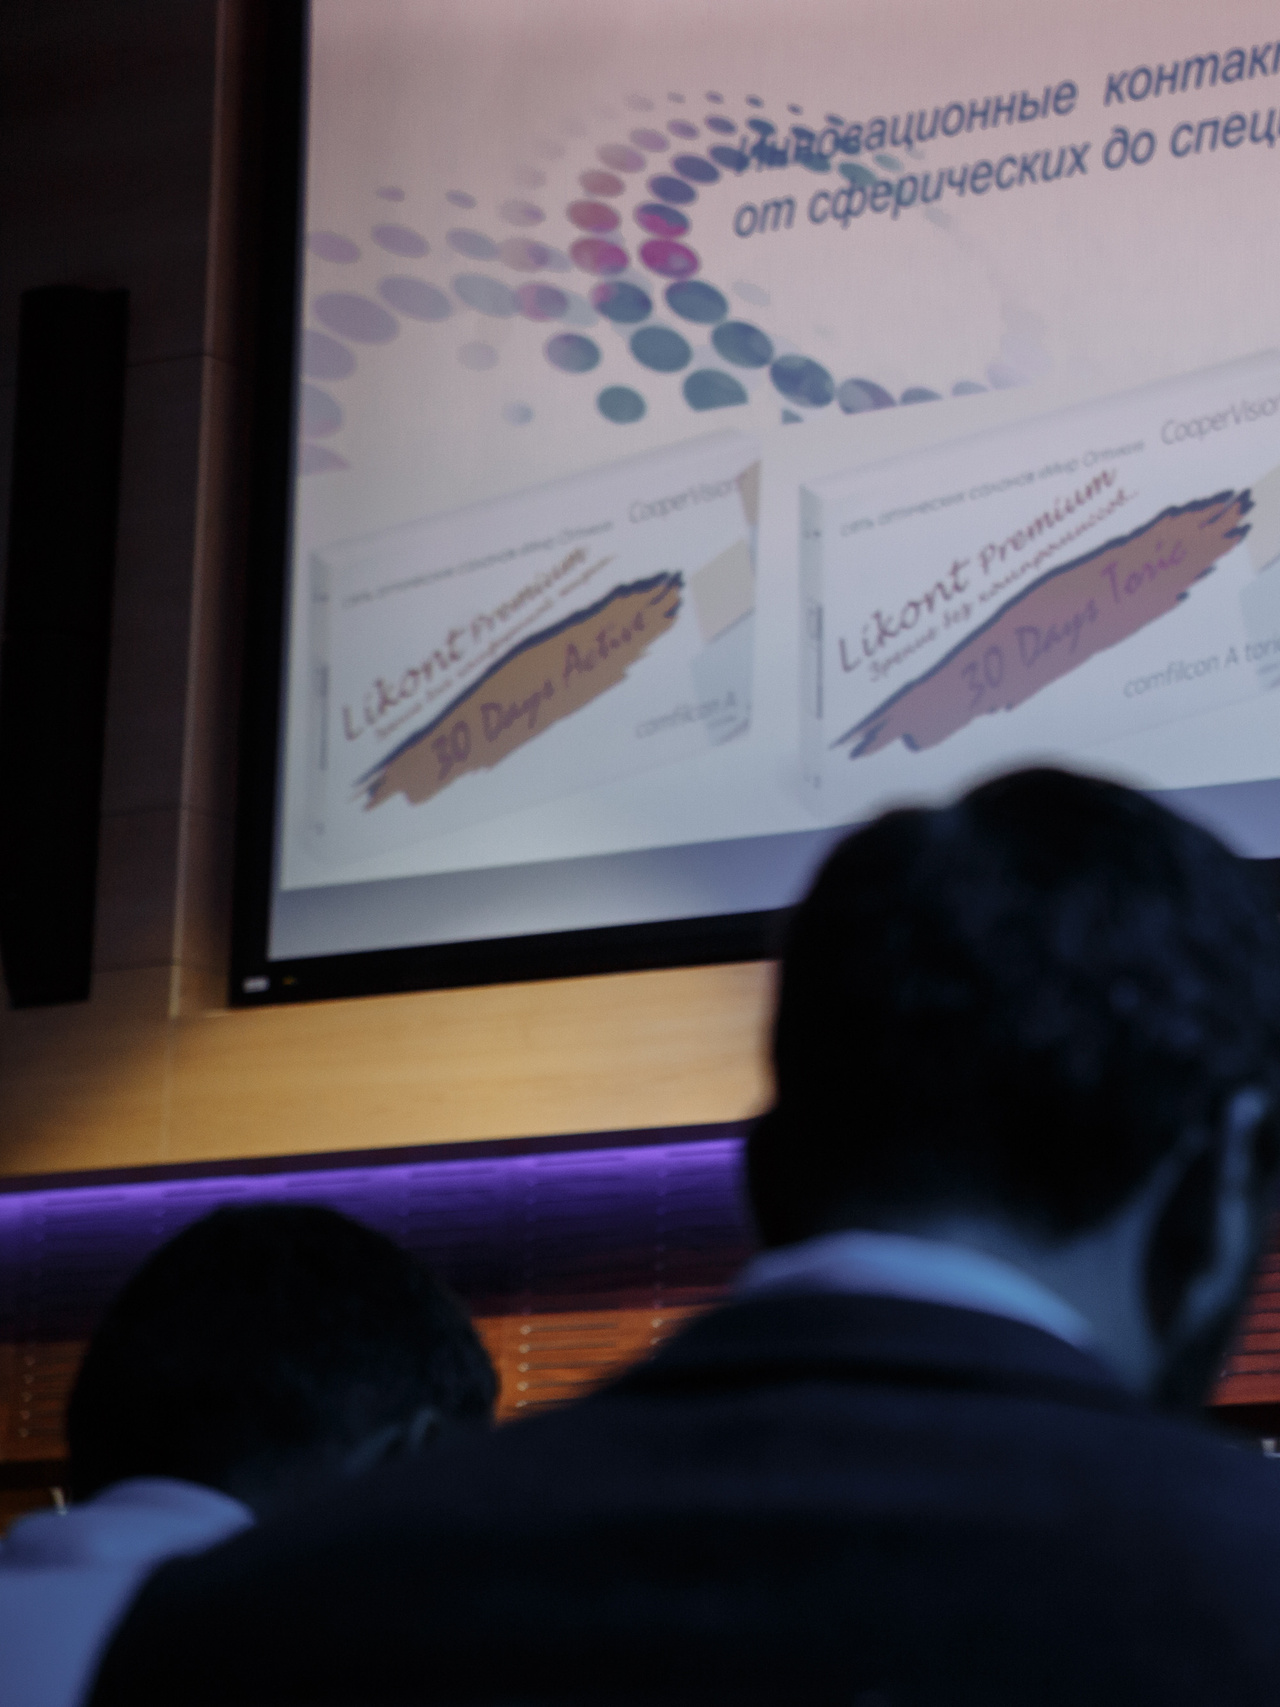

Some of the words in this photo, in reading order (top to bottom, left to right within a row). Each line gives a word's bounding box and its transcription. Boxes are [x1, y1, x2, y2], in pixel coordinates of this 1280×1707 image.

[733, 194, 797, 238] от
[807, 141, 1092, 230] сферических
[1102, 124, 1157, 170] до
[838, 556, 972, 674] Likont
[976, 467, 1119, 576] Premium
[1013, 598, 1100, 669] Days
[1100, 538, 1190, 606] Toric
[341, 627, 466, 741] Likont
[480, 678, 556, 743] Days
[1122, 655, 1221, 699] comfilcon
